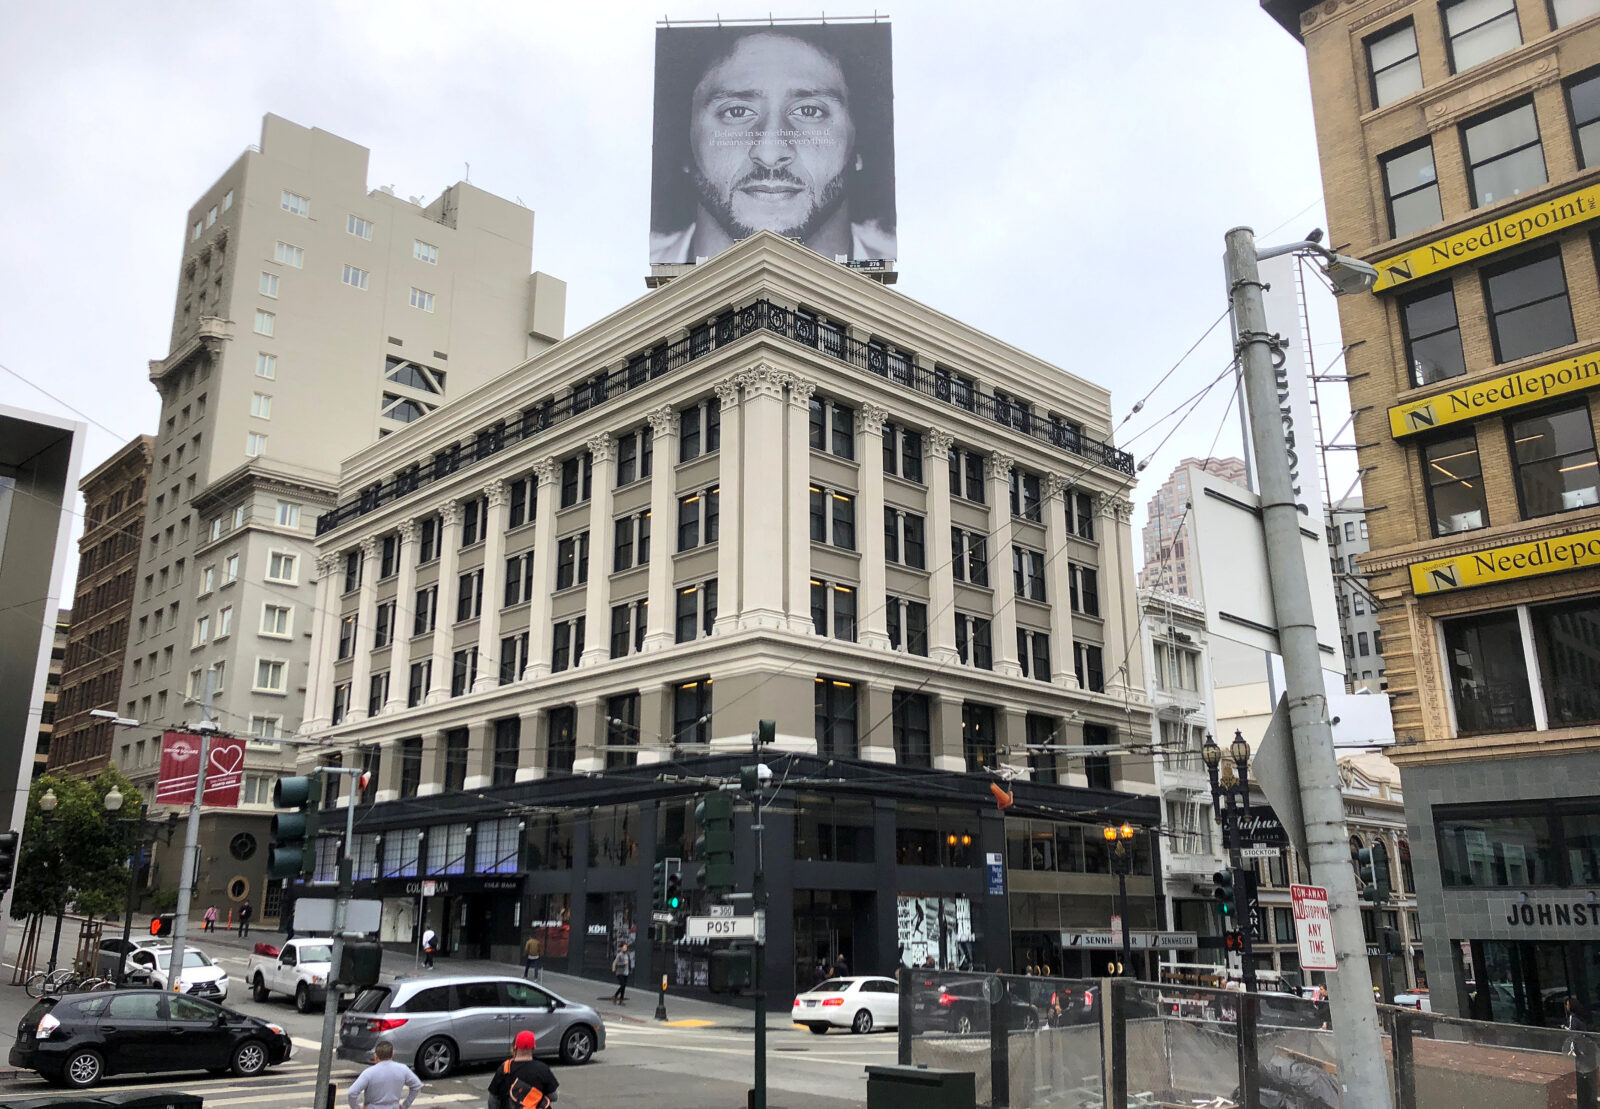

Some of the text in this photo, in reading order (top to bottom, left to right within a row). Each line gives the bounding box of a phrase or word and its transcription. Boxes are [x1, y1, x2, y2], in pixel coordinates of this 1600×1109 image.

[745, 129, 754, 137] in
[744, 138, 787, 147] sacriing
[1429, 195, 1587, 266] Needlepoint
[1387, 259, 1413, 285] N
[1447, 359, 1600, 414] Needlepoin
[1409, 405, 1434, 430] N
[1430, 564, 1458, 590] N
[406, 882, 424, 894] COL
[1292, 887, 1325, 900] TOW-AWAY
[1248, 898, 1259, 935] ZARA
[1294, 900, 1329, 920] NO STOPPING
[1507, 903, 1600, 926] JOHNST
[707, 921, 736, 934] POST
[1308, 923, 1322, 937] ANY
[1085, 936, 1137, 945] SENNHER
[1161, 936, 1193, 945] SENNHEISER
[1308, 940, 1327, 955] TIME
